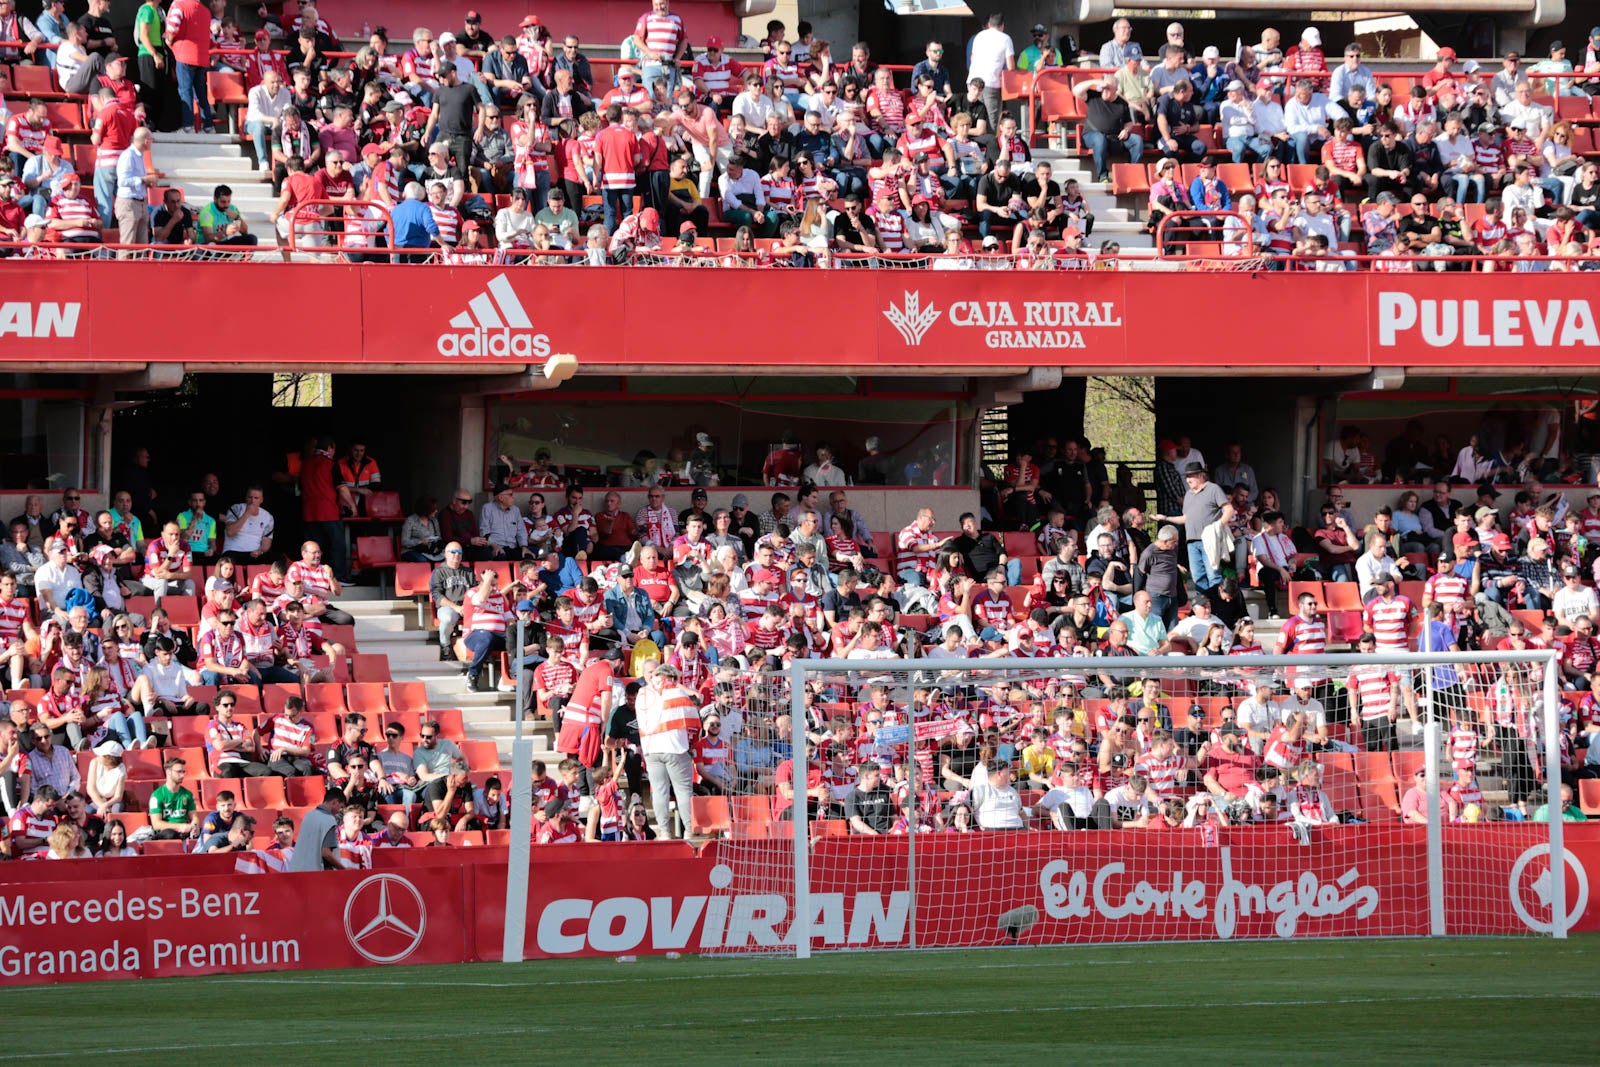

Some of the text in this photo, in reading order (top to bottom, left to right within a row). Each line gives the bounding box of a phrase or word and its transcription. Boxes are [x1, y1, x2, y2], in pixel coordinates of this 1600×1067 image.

[949, 301, 1122, 328] CAJA RURAL
[1379, 291, 1600, 347] PULEVA
[437, 326, 551, 358] adidas
[985, 330, 1086, 348] GRANADA
[0, 888, 260, 927] Mercedes-Benz
[1040, 847, 1379, 938] El Corte Inglés
[0, 934, 300, 976] Granada Premium
